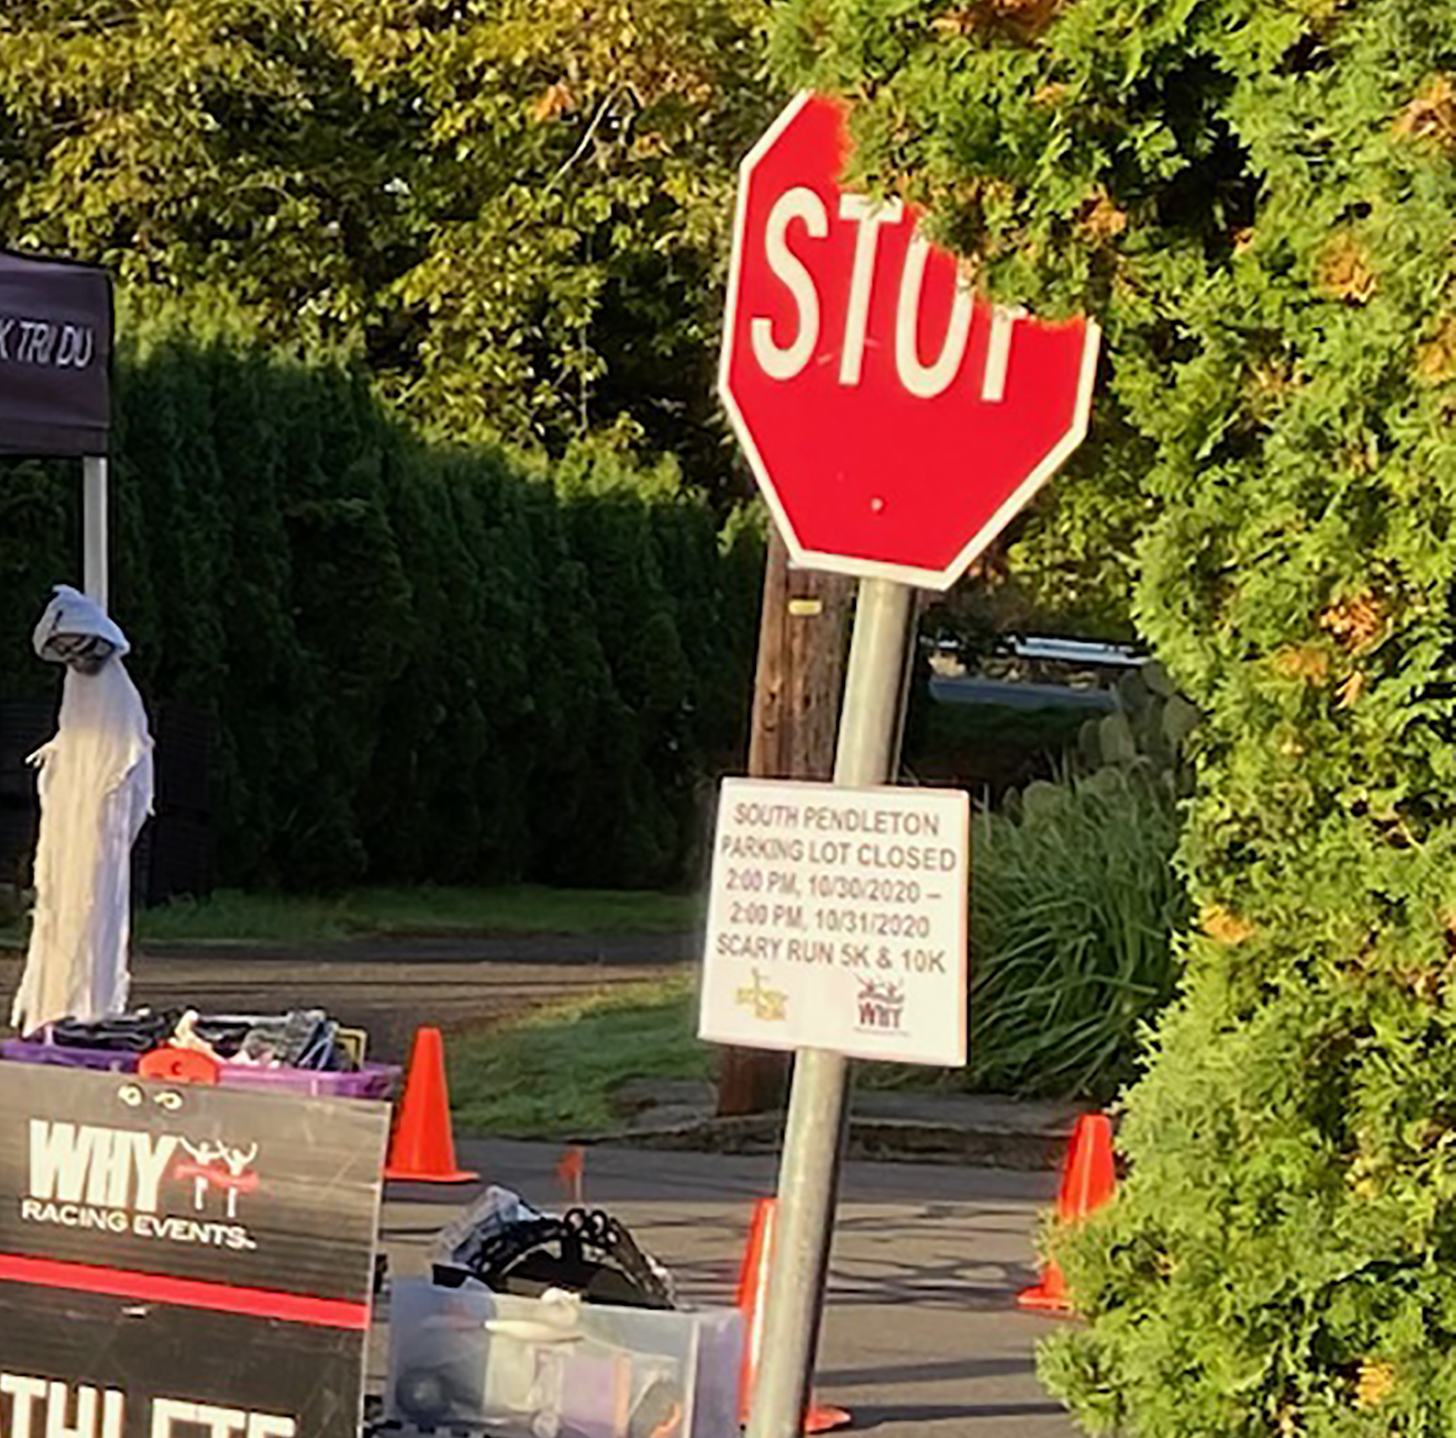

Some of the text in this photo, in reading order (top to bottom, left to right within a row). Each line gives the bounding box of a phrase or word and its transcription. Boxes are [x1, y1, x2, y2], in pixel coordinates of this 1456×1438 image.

[16, 318, 58, 367] TRI
[58, 328, 95, 371] DU
[732, 802, 940, 838] SOUTH PENDLETON
[721, 834, 958, 873] PARKING LOT CLOSED
[725, 868, 764, 893] 2:00
[809, 874, 922, 905] 10/30/2020
[730, 901, 769, 927] 2:00
[815, 908, 931, 940] 10/31/2020
[716, 932, 947, 974] SCARY RUN 5K & 10K
[28, 1118, 179, 1215] WHY
[21, 1197, 250, 1252] RACING EVENTS
